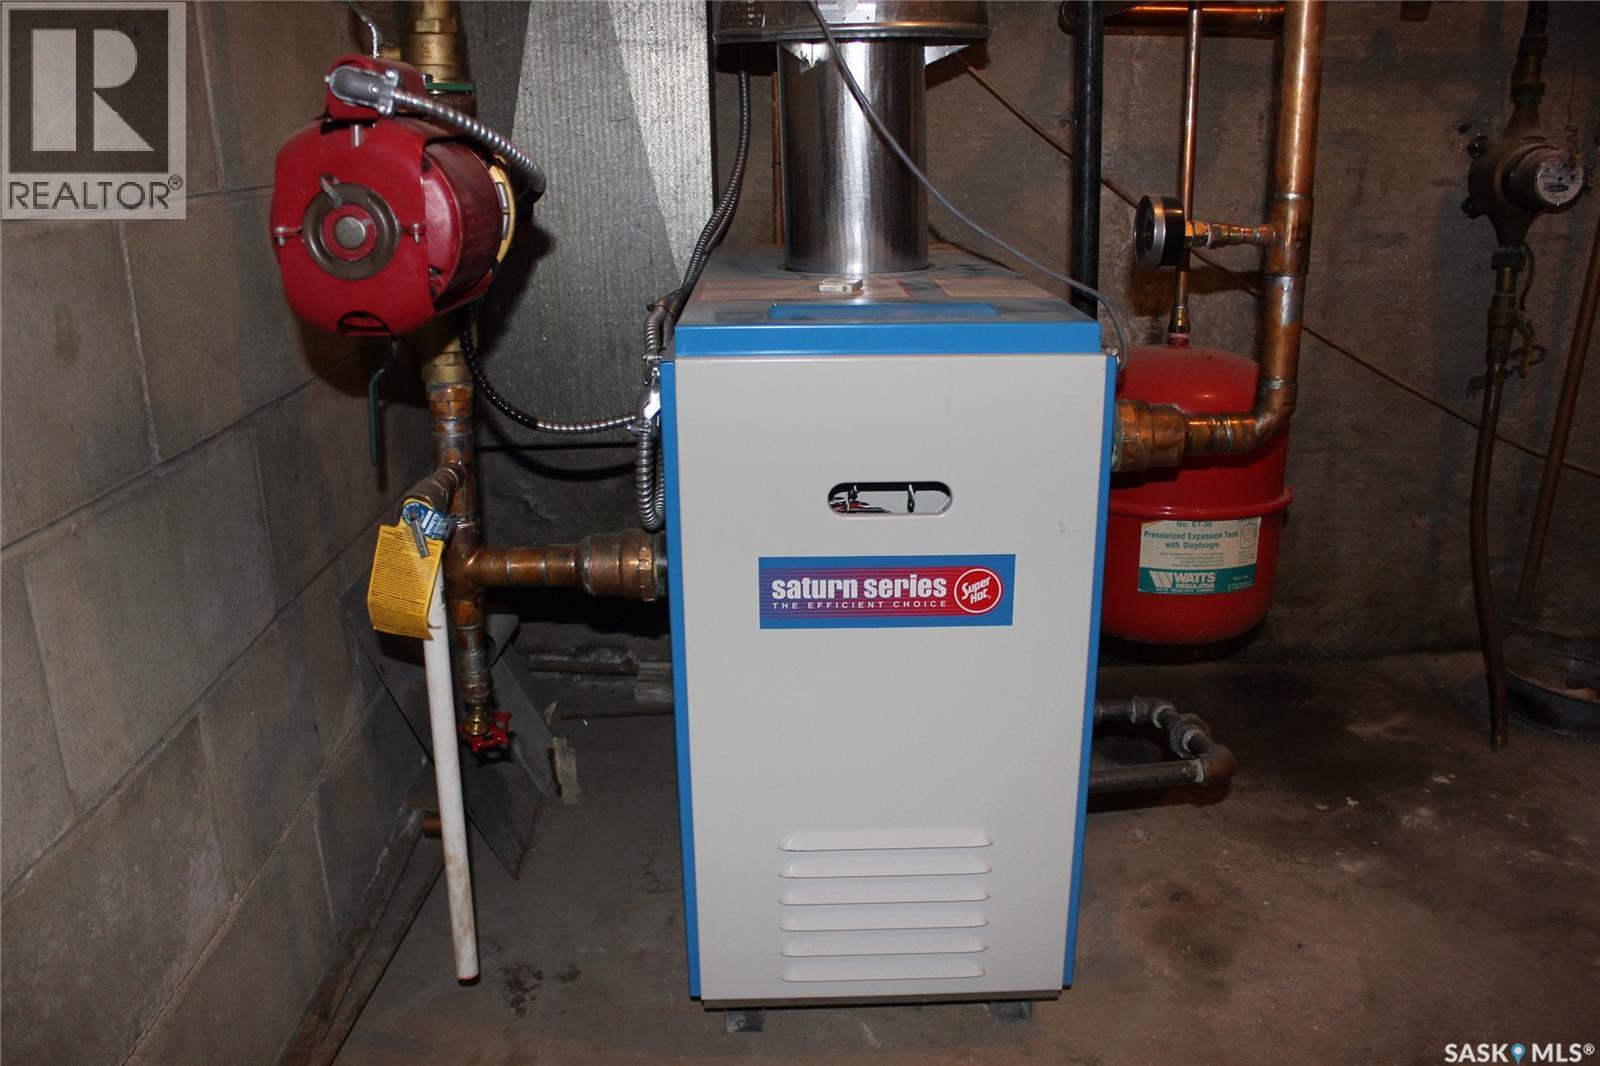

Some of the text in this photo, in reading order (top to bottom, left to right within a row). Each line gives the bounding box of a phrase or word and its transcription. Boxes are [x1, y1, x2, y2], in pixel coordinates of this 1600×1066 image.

[1143, 530, 1239, 541] Pressurized Expansion Tank
[1183, 541, 1220, 550] Diaphragm
[1174, 572, 1216, 583] WATTS
[772, 574, 947, 599] saturn series
[961, 576, 991, 600] Super
[808, 601, 885, 609] EFFICIENT
[893, 600, 947, 608] CHOICE
